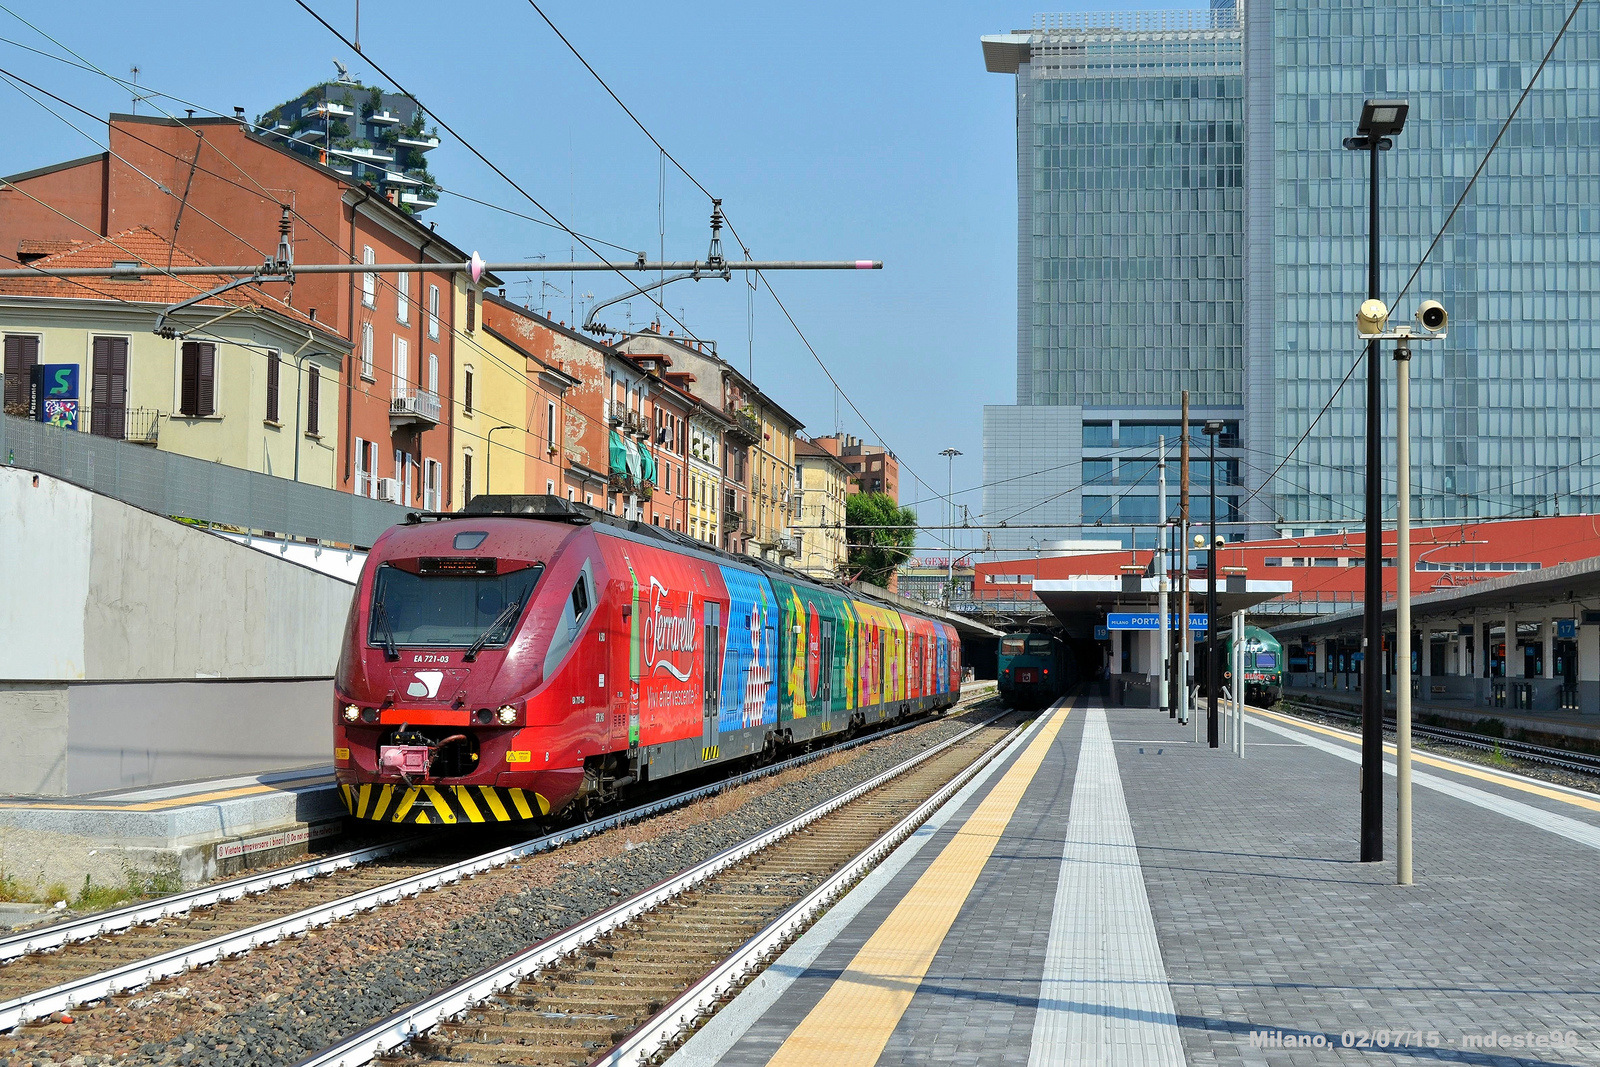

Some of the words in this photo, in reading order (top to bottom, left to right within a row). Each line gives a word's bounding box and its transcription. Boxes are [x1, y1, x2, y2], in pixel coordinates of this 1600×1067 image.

[50, 369, 72, 394] S
[644, 575, 696, 667] Ferrarelle
[1131, 617, 1160, 625] PORTA
[1097, 628, 1106, 636] 19
[1561, 625, 1572, 633] 17
[413, 655, 423, 663] EA
[424, 655, 450, 663] 721-03
[224, 845, 241, 856] Vietato
